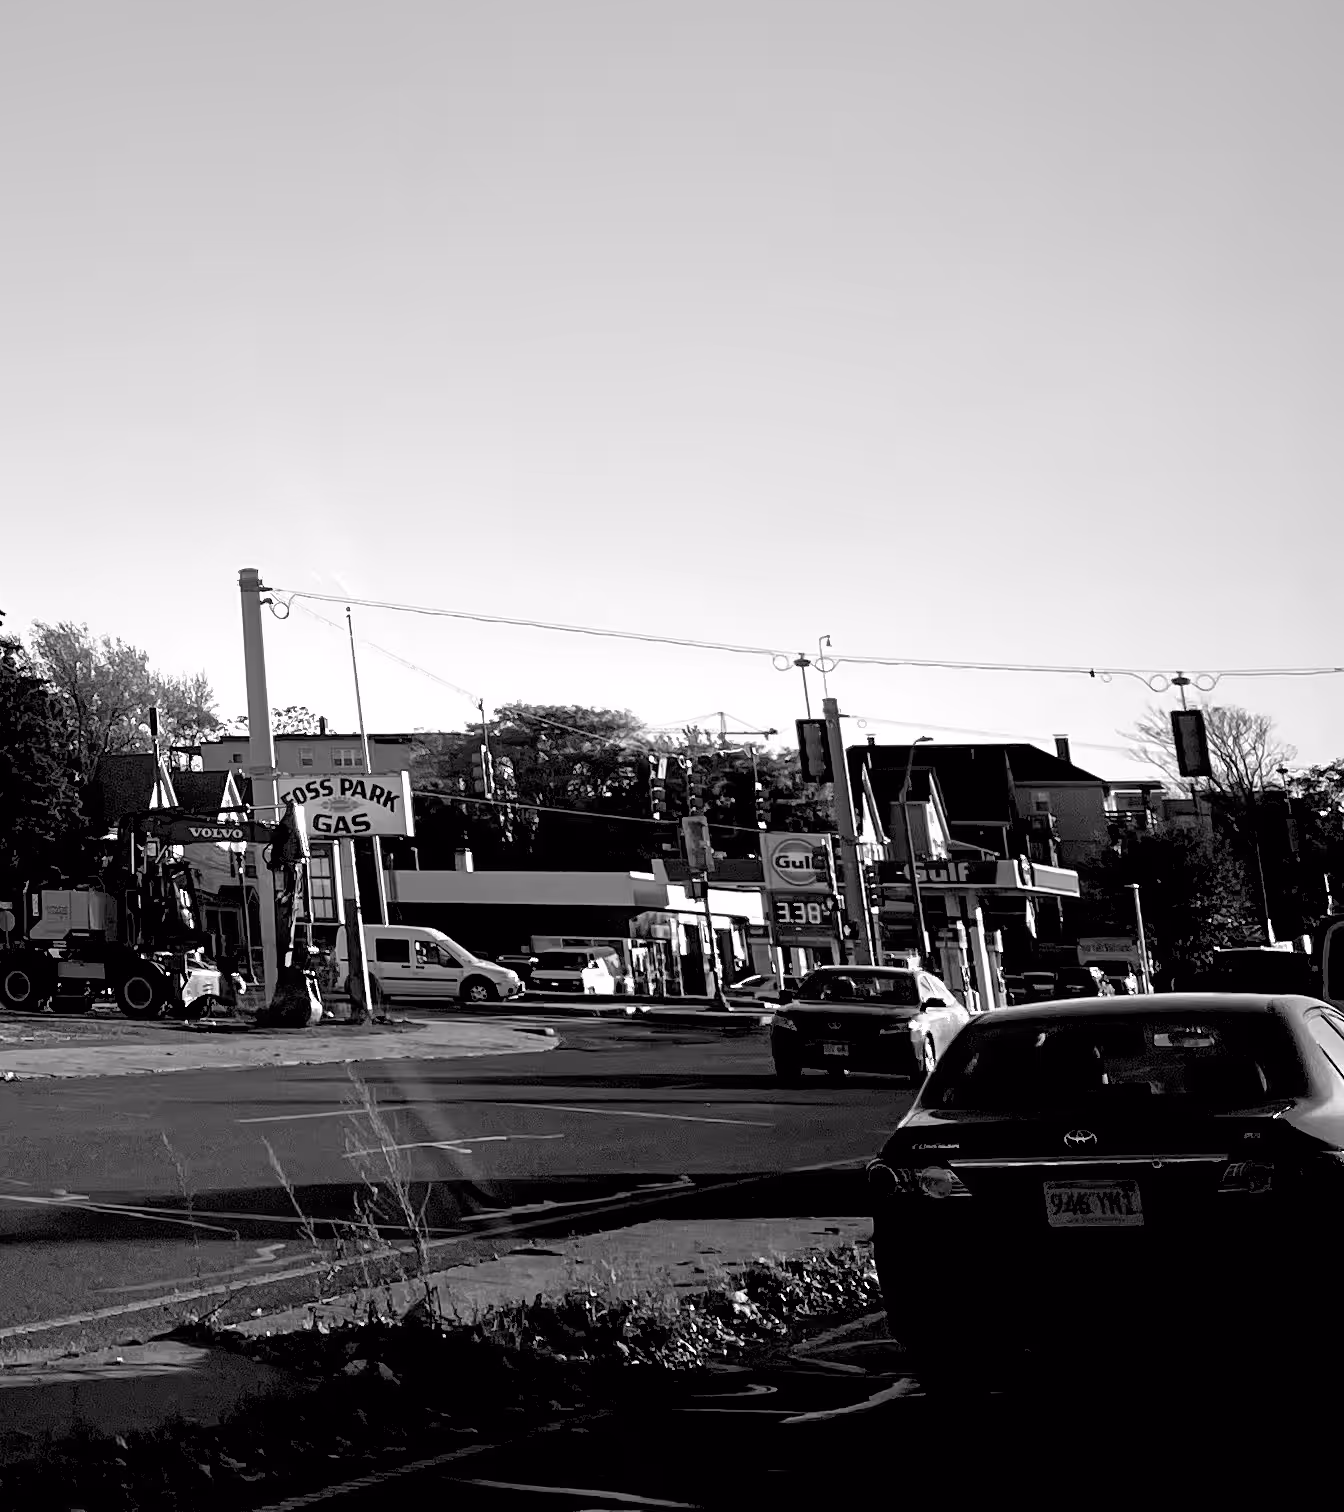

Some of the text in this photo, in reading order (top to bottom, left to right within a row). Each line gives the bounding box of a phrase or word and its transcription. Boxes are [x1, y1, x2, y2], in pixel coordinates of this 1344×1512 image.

[280, 777, 401, 813] FOSS PARK
[188, 826, 244, 839] VOLVO
[312, 812, 372, 834] GAS
[775, 854, 815, 870] Gul
